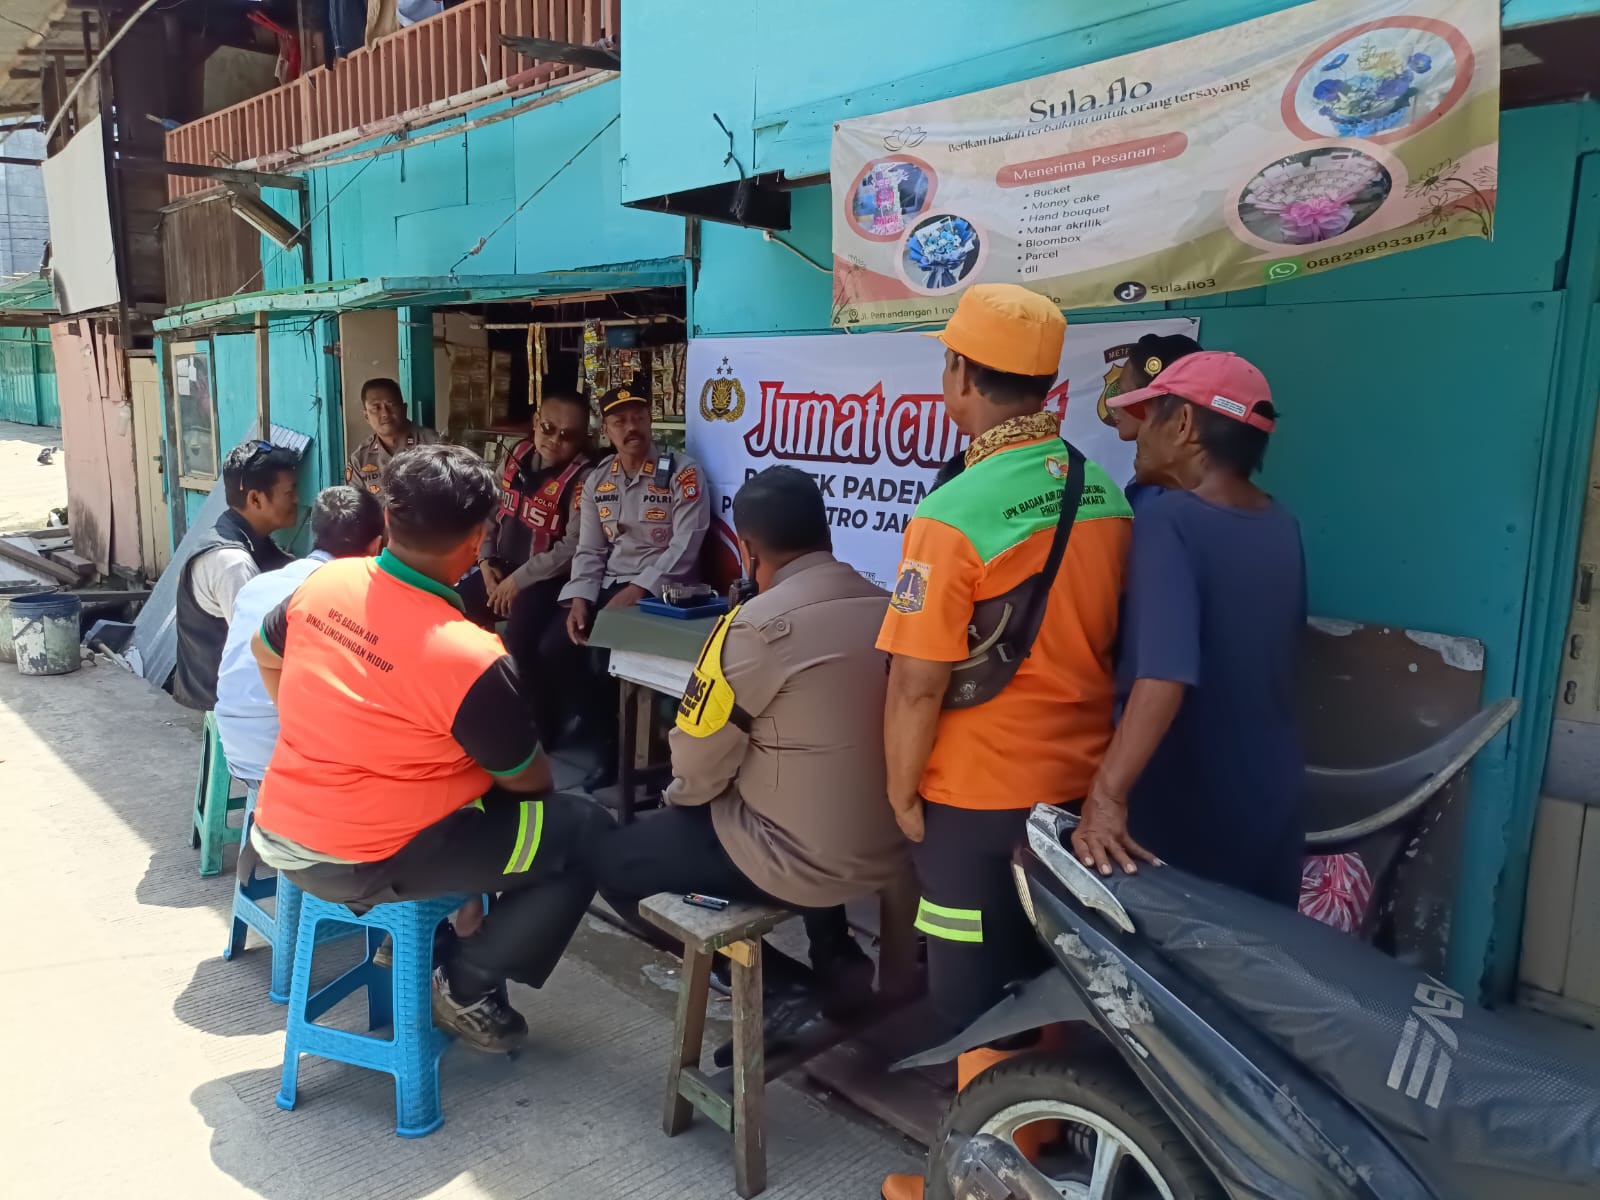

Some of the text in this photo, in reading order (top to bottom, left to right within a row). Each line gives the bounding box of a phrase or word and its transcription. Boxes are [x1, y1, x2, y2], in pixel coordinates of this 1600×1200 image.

[1029, 77, 1153, 122] Sula.flo
[1091, 107, 1128, 122] untuk
[1131, 97, 1172, 113] orang
[1175, 78, 1251, 103] tersayang
[1014, 160, 1085, 180] Menerima
[1092, 146, 1155, 167] Pesanan
[1033, 185, 1071, 197] Bucket
[1031, 194, 1101, 210] Money cake
[1028, 204, 1110, 222] Hand bouquet
[1026, 218, 1102, 234] Mahar akrilik
[1025, 235, 1081, 248] Bloombox
[1306, 227, 1448, 269] 088298933874
[1025, 250, 1058, 260] Parcel
[1025, 265, 1038, 273] dll
[743, 381, 885, 464] Jumat
[643, 495, 672, 503] POLRI
[1018, 495, 1045, 513] BADAN
[825, 506, 868, 529] TRO
[328, 607, 379, 646] UPS BADAN AIR
[306, 613, 394, 673] DINAS LINGKUNGAN HIDUP
